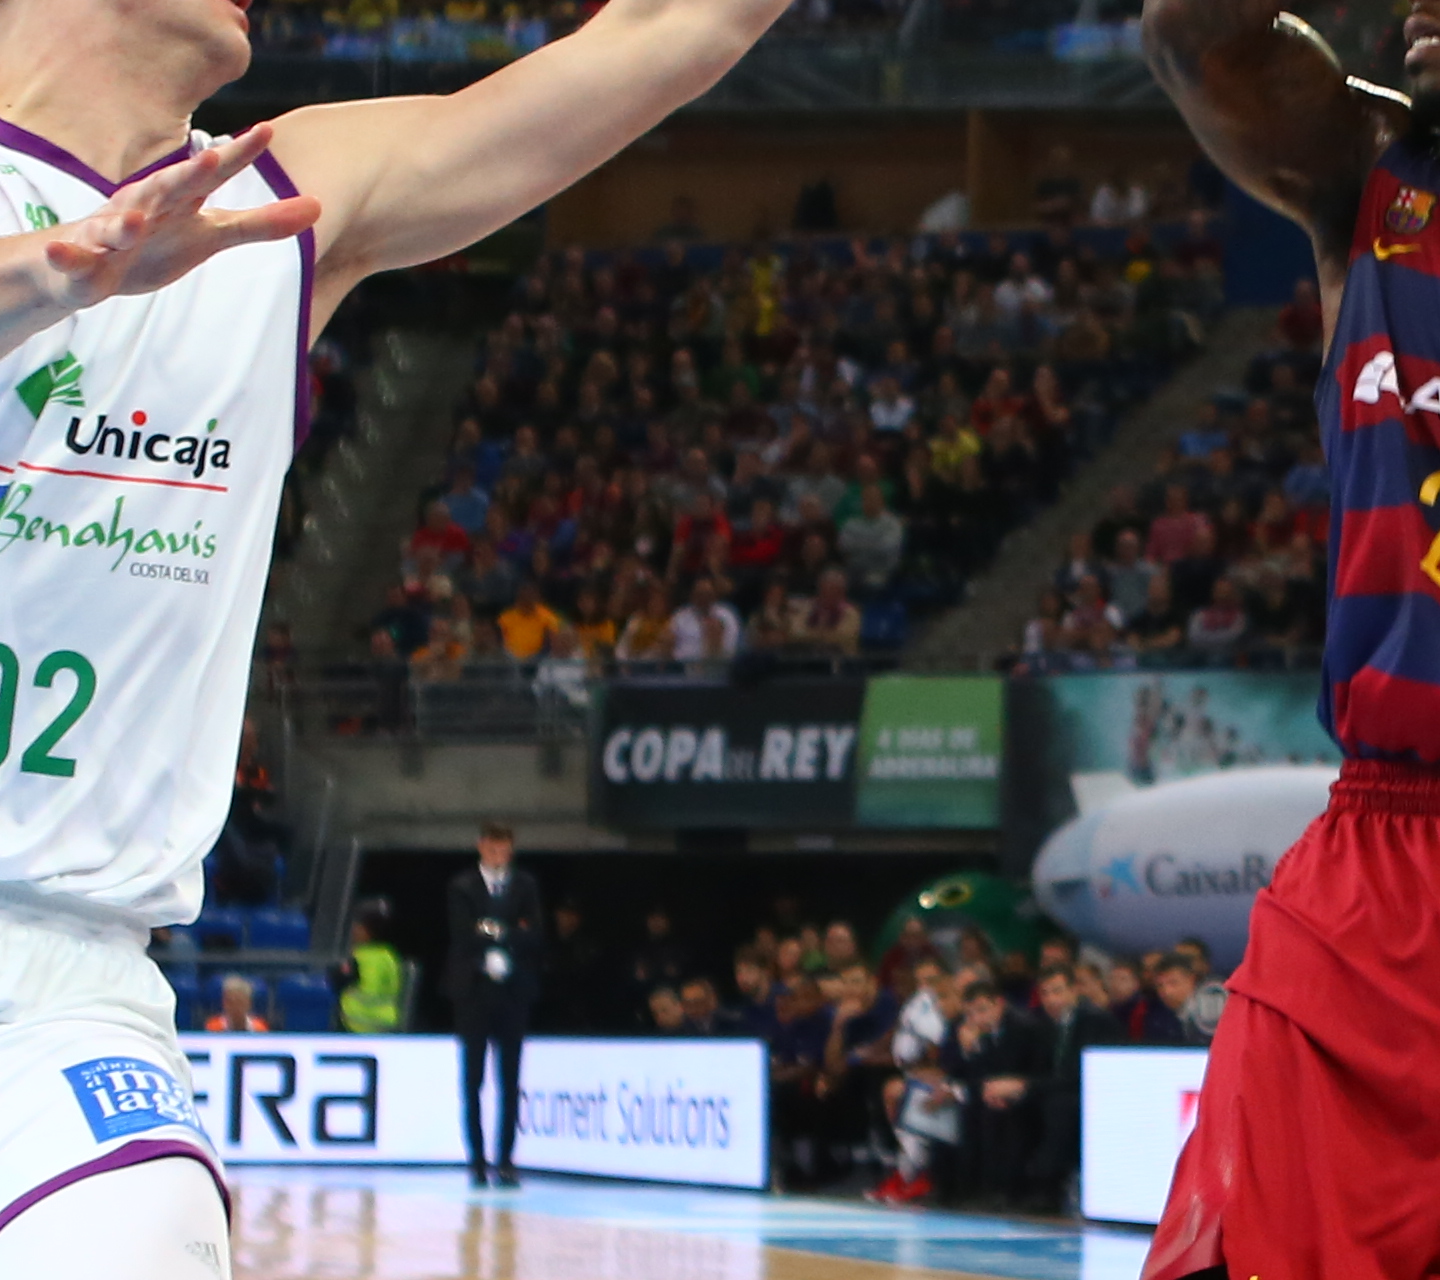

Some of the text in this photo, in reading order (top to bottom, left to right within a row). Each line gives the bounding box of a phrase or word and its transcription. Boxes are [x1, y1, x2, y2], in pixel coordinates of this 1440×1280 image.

[65, 410, 231, 478] Unicaja
[130, 562, 172, 580] COSTA
[602, 728, 726, 784] COPA
[760, 728, 855, 782] REY
[1145, 853, 1272, 896] CaixaB
[518, 1075, 731, 1149] ocument Solutions
